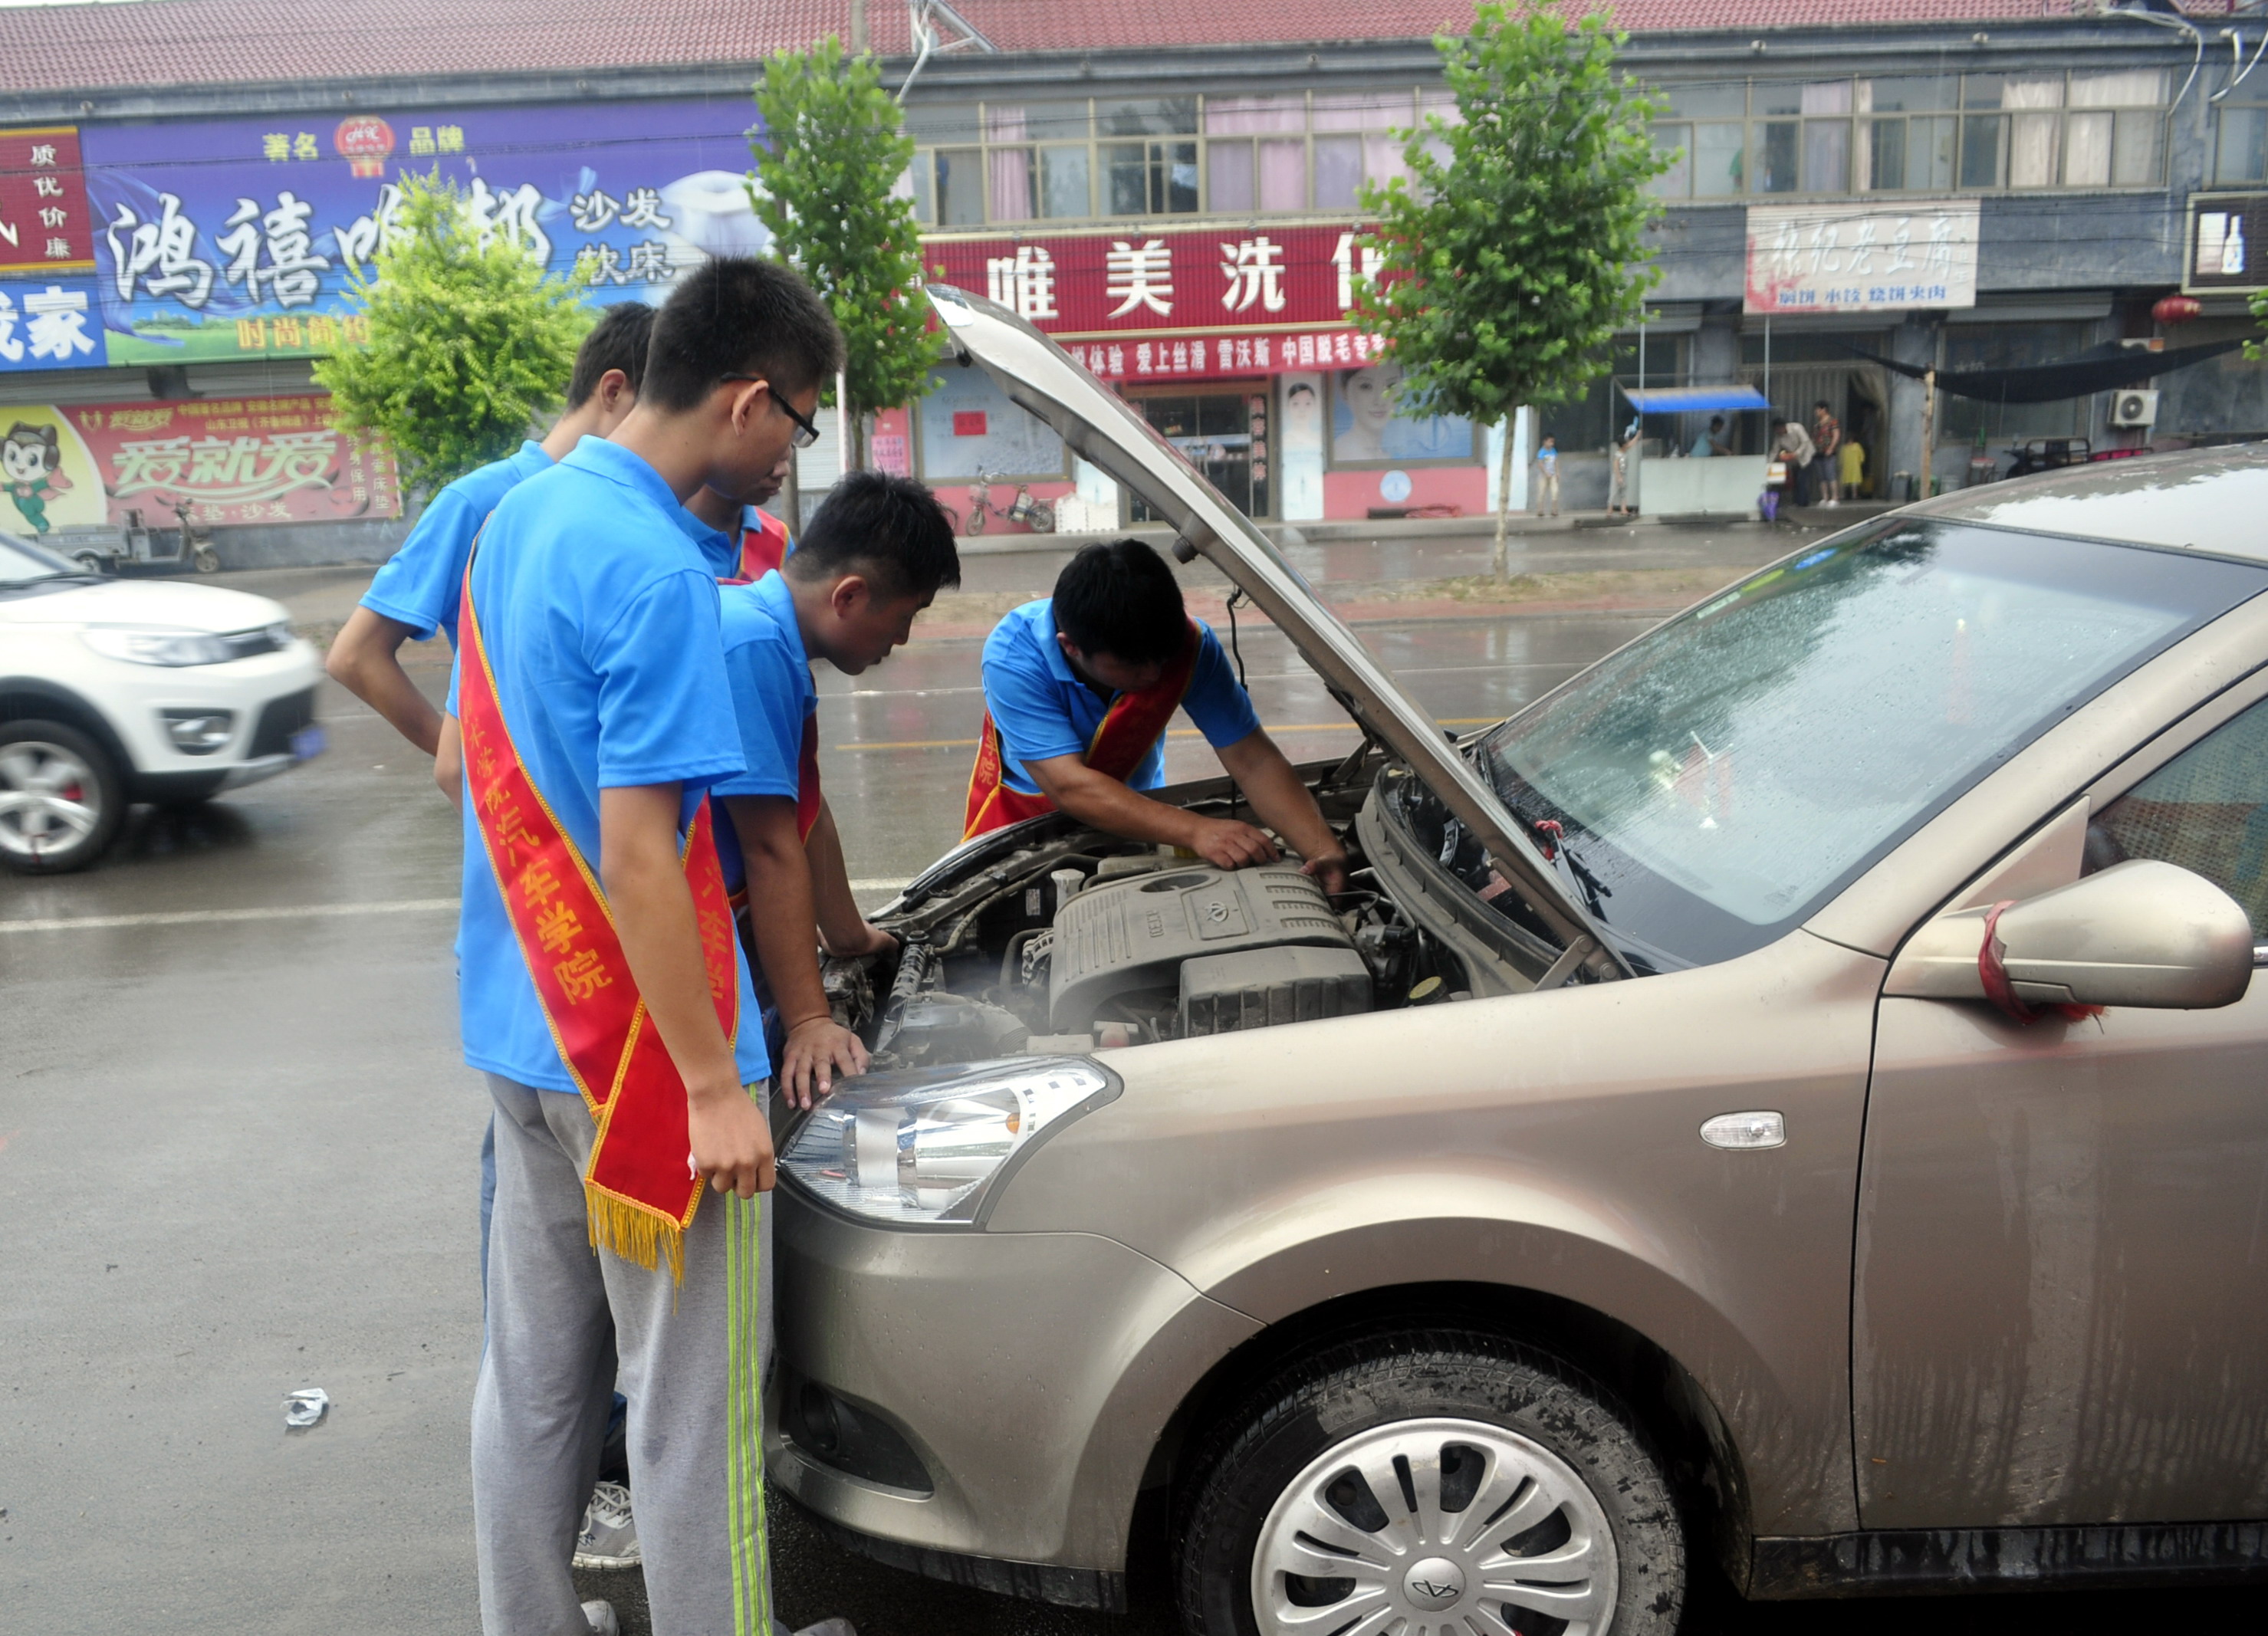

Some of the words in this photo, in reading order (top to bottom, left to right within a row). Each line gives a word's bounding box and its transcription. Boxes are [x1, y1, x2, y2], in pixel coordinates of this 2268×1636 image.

[262, 132, 318, 162] 著名
[409, 125, 464, 156] 品牌
[30, 144, 71, 259] 质优价廉
[570, 187, 672, 232] 沙发
[577, 240, 675, 286] 软床
[1136, 340, 1207, 373] 爱上丝滑
[1217, 337, 1270, 370] 雷沃斯
[113, 429, 337, 500] 爱就爱
